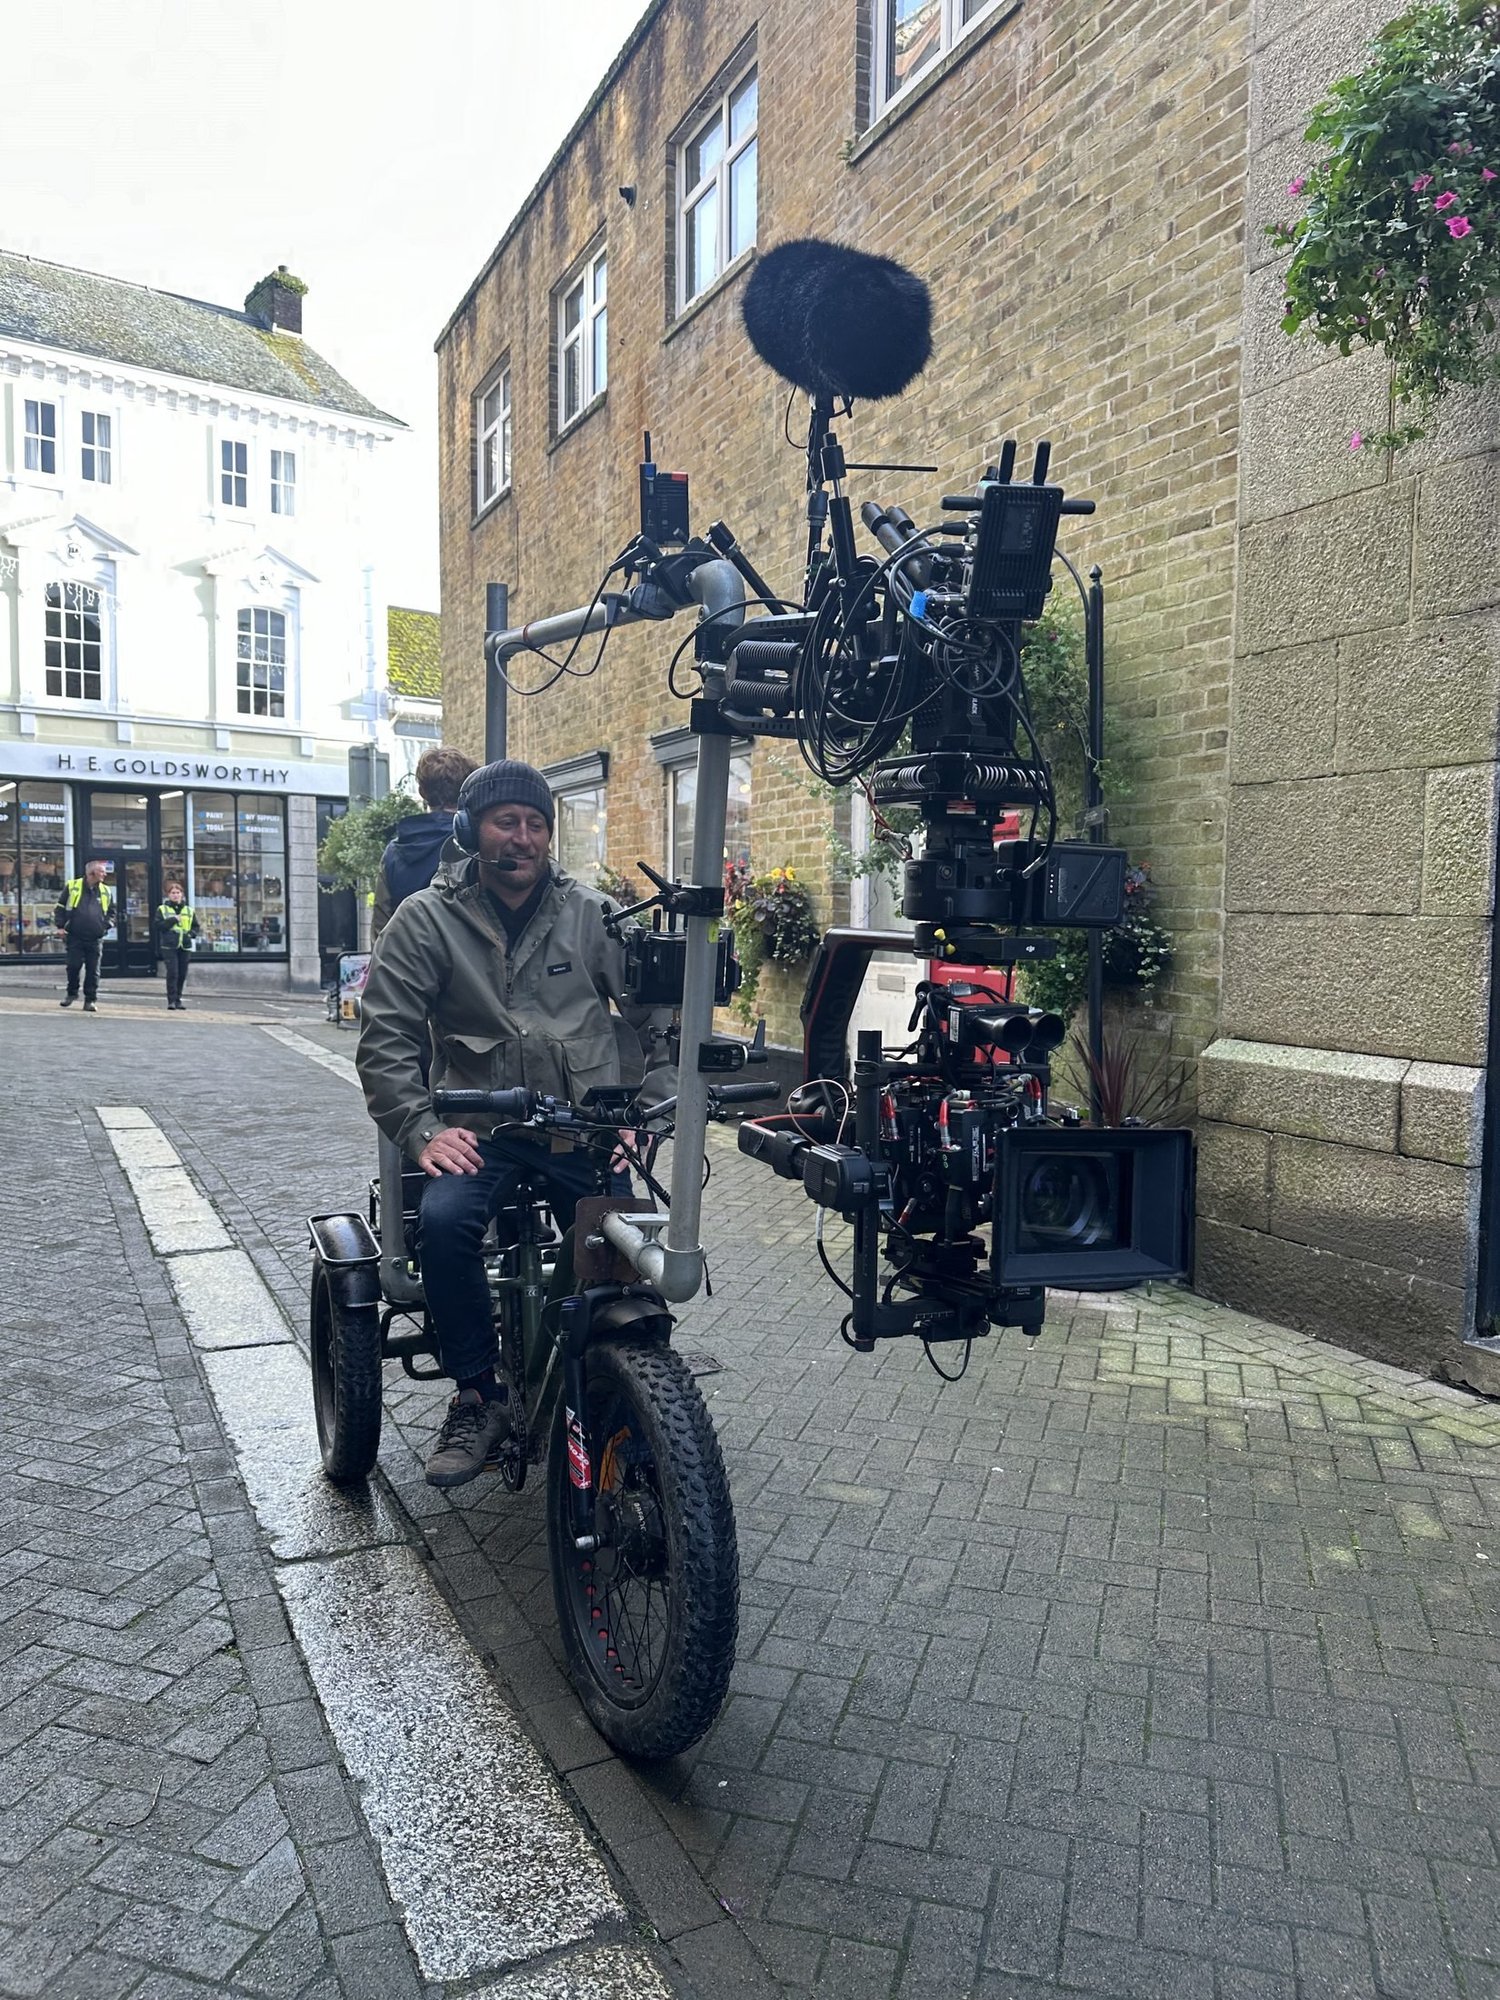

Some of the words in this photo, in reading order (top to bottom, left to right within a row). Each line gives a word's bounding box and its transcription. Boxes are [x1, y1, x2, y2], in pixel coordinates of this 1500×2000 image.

[58, 754, 75, 770] H.
[88, 757, 101, 772] E.
[114, 758, 290, 783] GOLDSWORTHY
[28, 815, 66, 823] HARDWARE
[206, 811, 224, 819] PAINT
[206, 824, 224, 832] TOOLS
